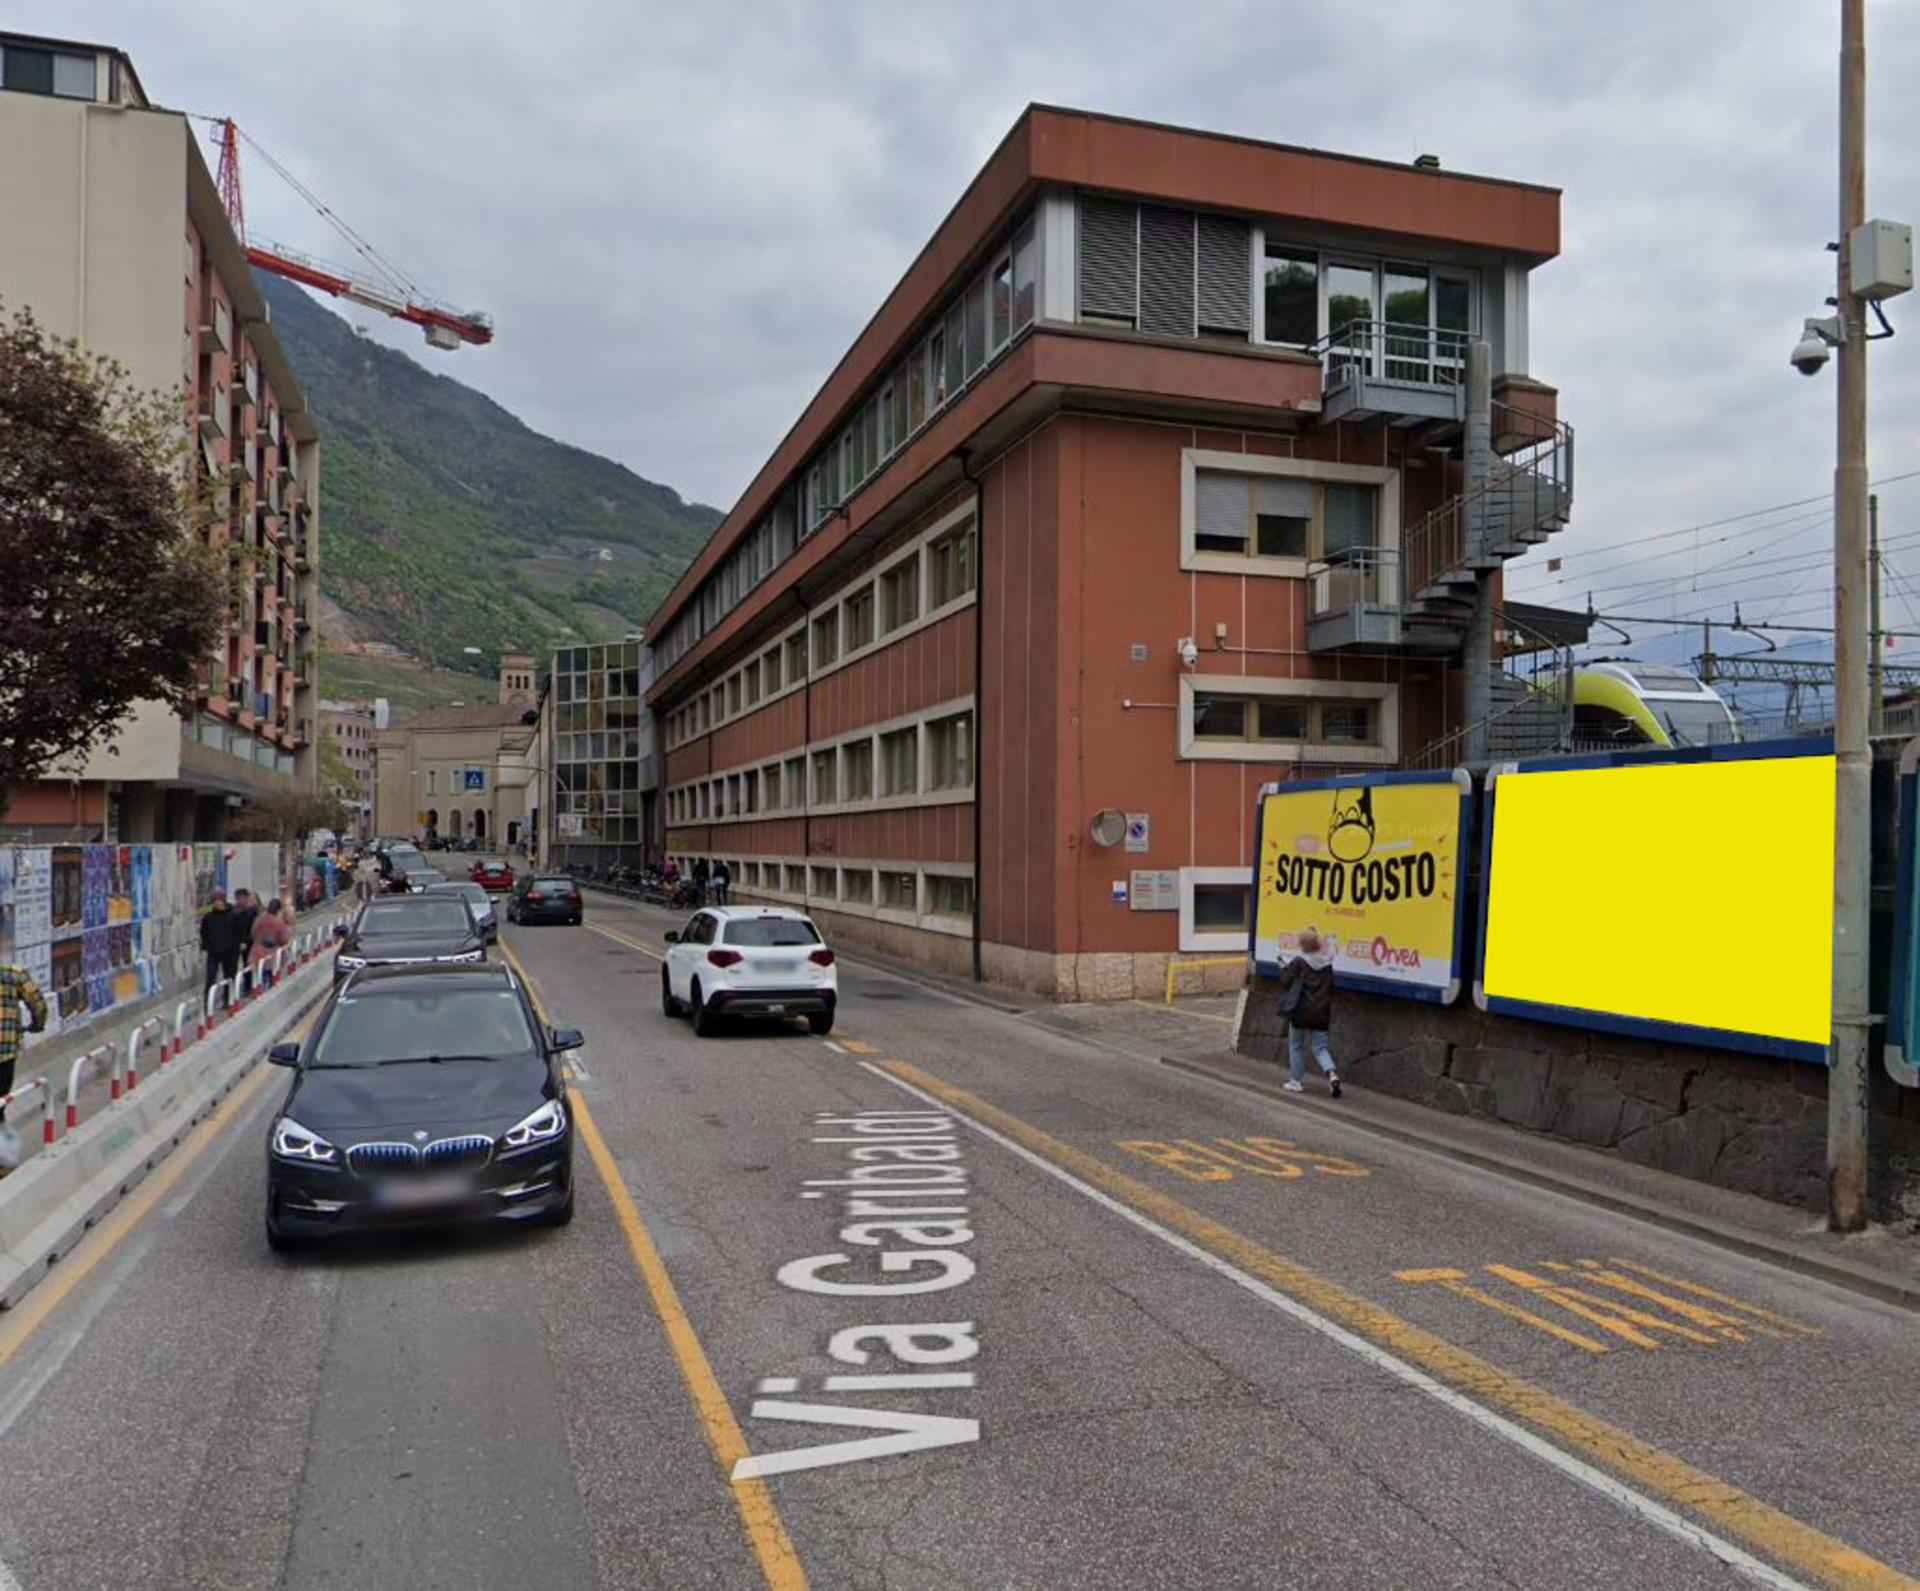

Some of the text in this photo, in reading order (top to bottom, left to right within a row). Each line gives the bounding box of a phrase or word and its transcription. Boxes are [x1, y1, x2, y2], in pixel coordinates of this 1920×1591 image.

[1276, 851, 1435, 905] SOTTO COSTO
[1371, 935, 1421, 968] Orvea
[1114, 1136, 1371, 1182] BUS
